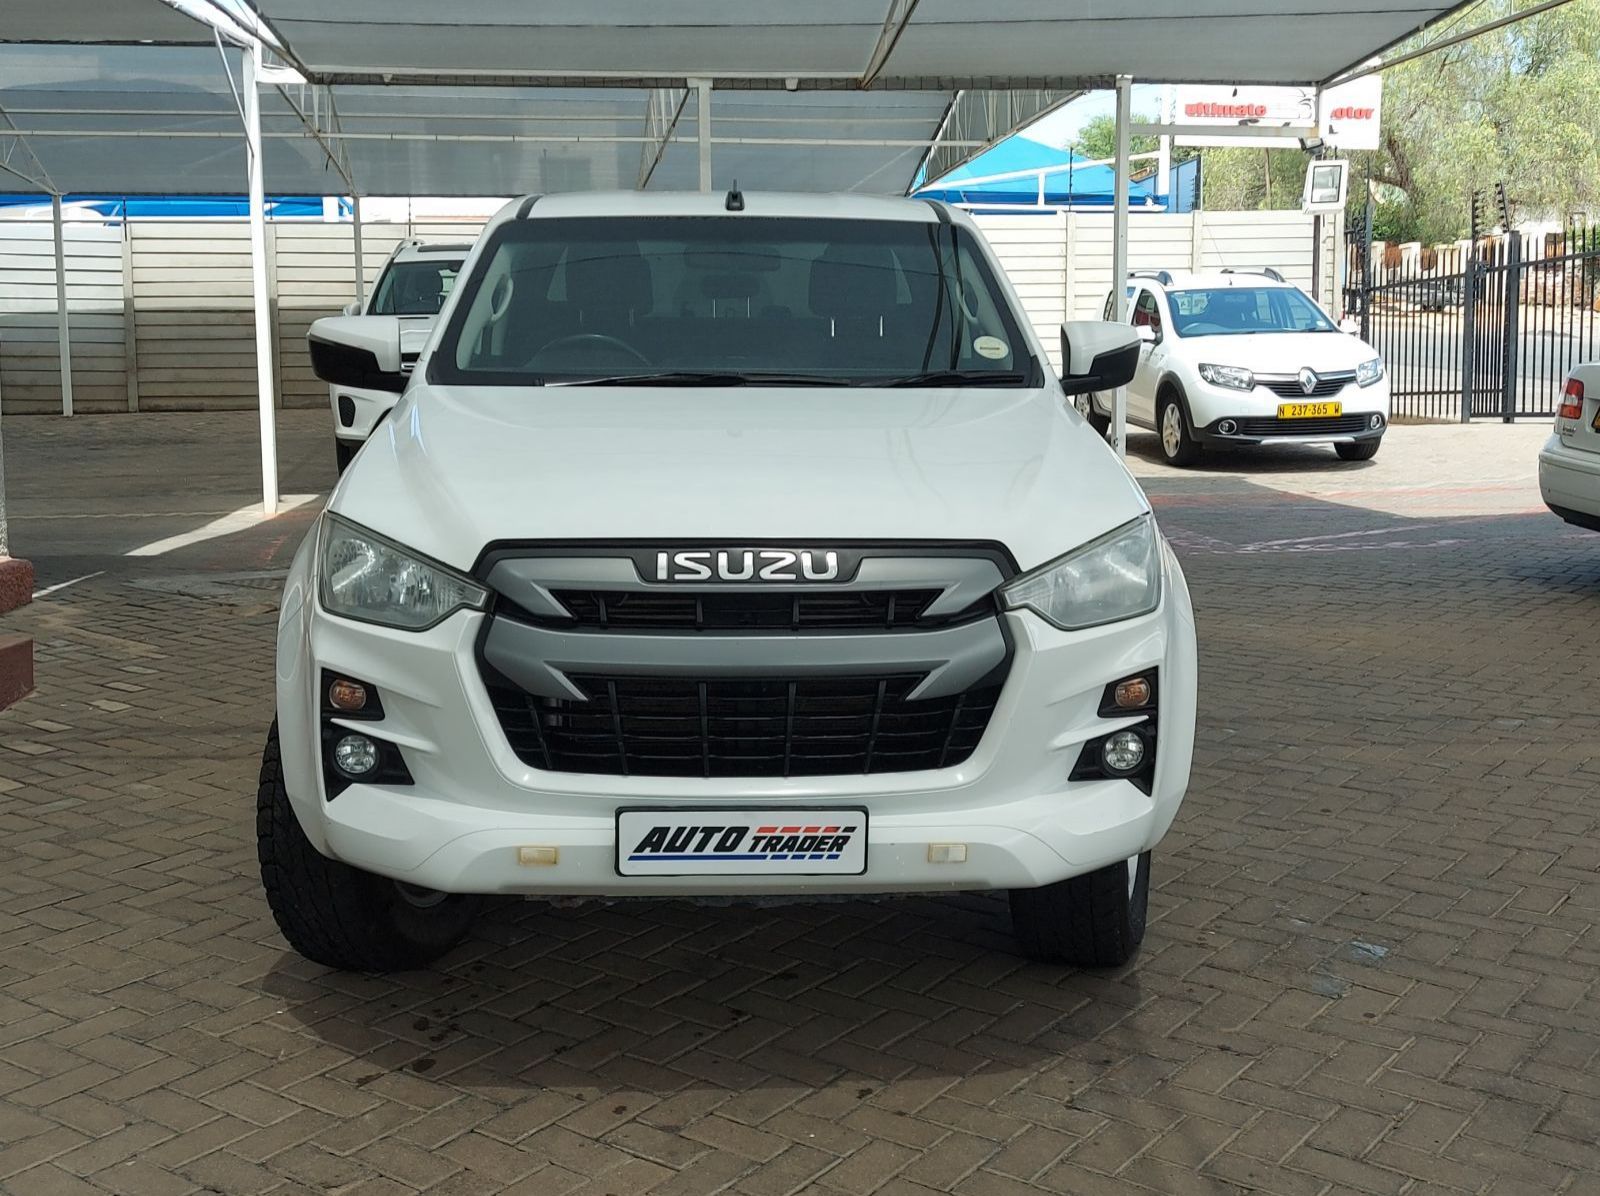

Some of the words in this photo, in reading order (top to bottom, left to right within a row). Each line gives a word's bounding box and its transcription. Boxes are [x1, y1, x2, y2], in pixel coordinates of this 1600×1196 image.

[1185, 102, 1267, 117] ultimate
[1331, 106, 1375, 119] otor
[1279, 406, 1285, 417] N
[1291, 404, 1328, 416] 237-365
[1334, 402, 1340, 414] W
[656, 551, 839, 581] ISUZU
[632, 826, 750, 853] AUTO
[748, 835, 851, 853] TRADER
